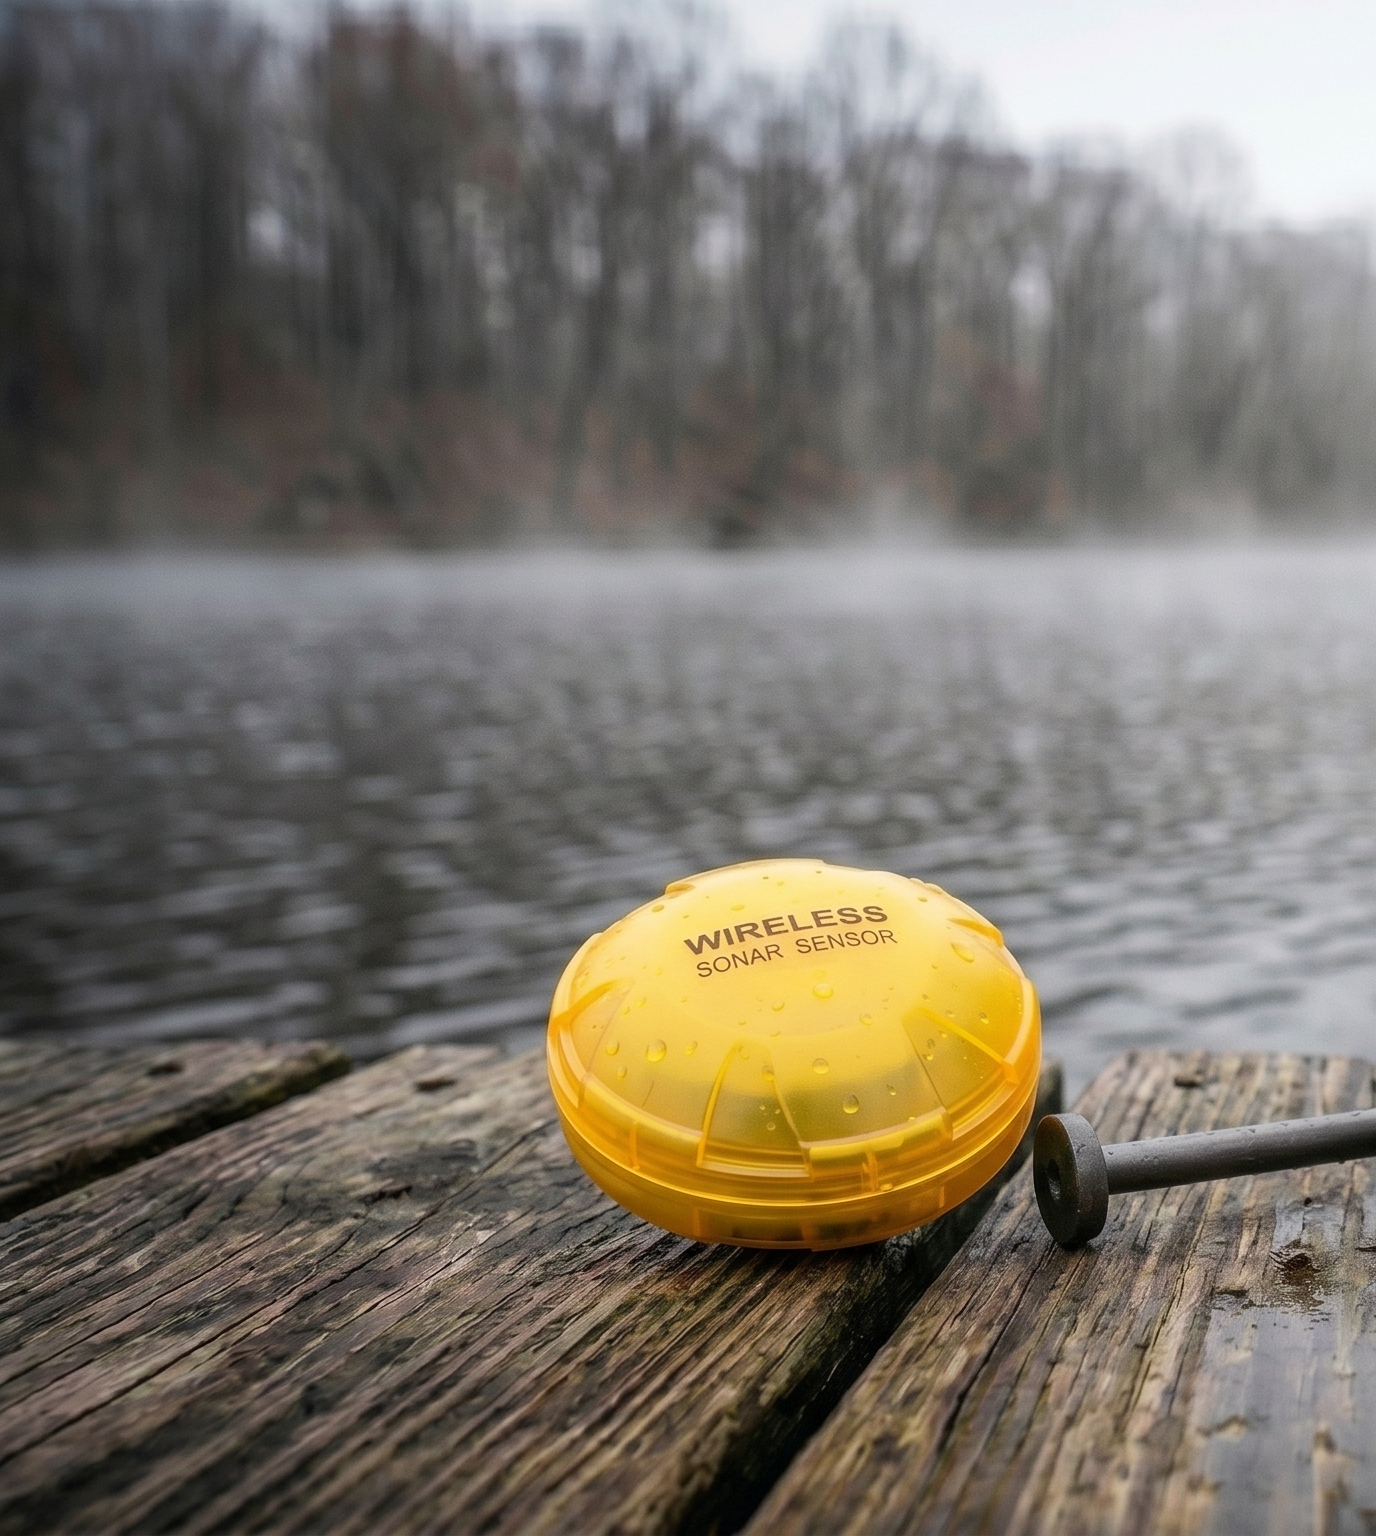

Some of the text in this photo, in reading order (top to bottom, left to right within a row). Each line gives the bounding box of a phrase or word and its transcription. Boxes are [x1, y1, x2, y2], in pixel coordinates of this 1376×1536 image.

[684, 905, 888, 956] WIRELESS
[696, 929, 898, 977] SONAR SENSOR
